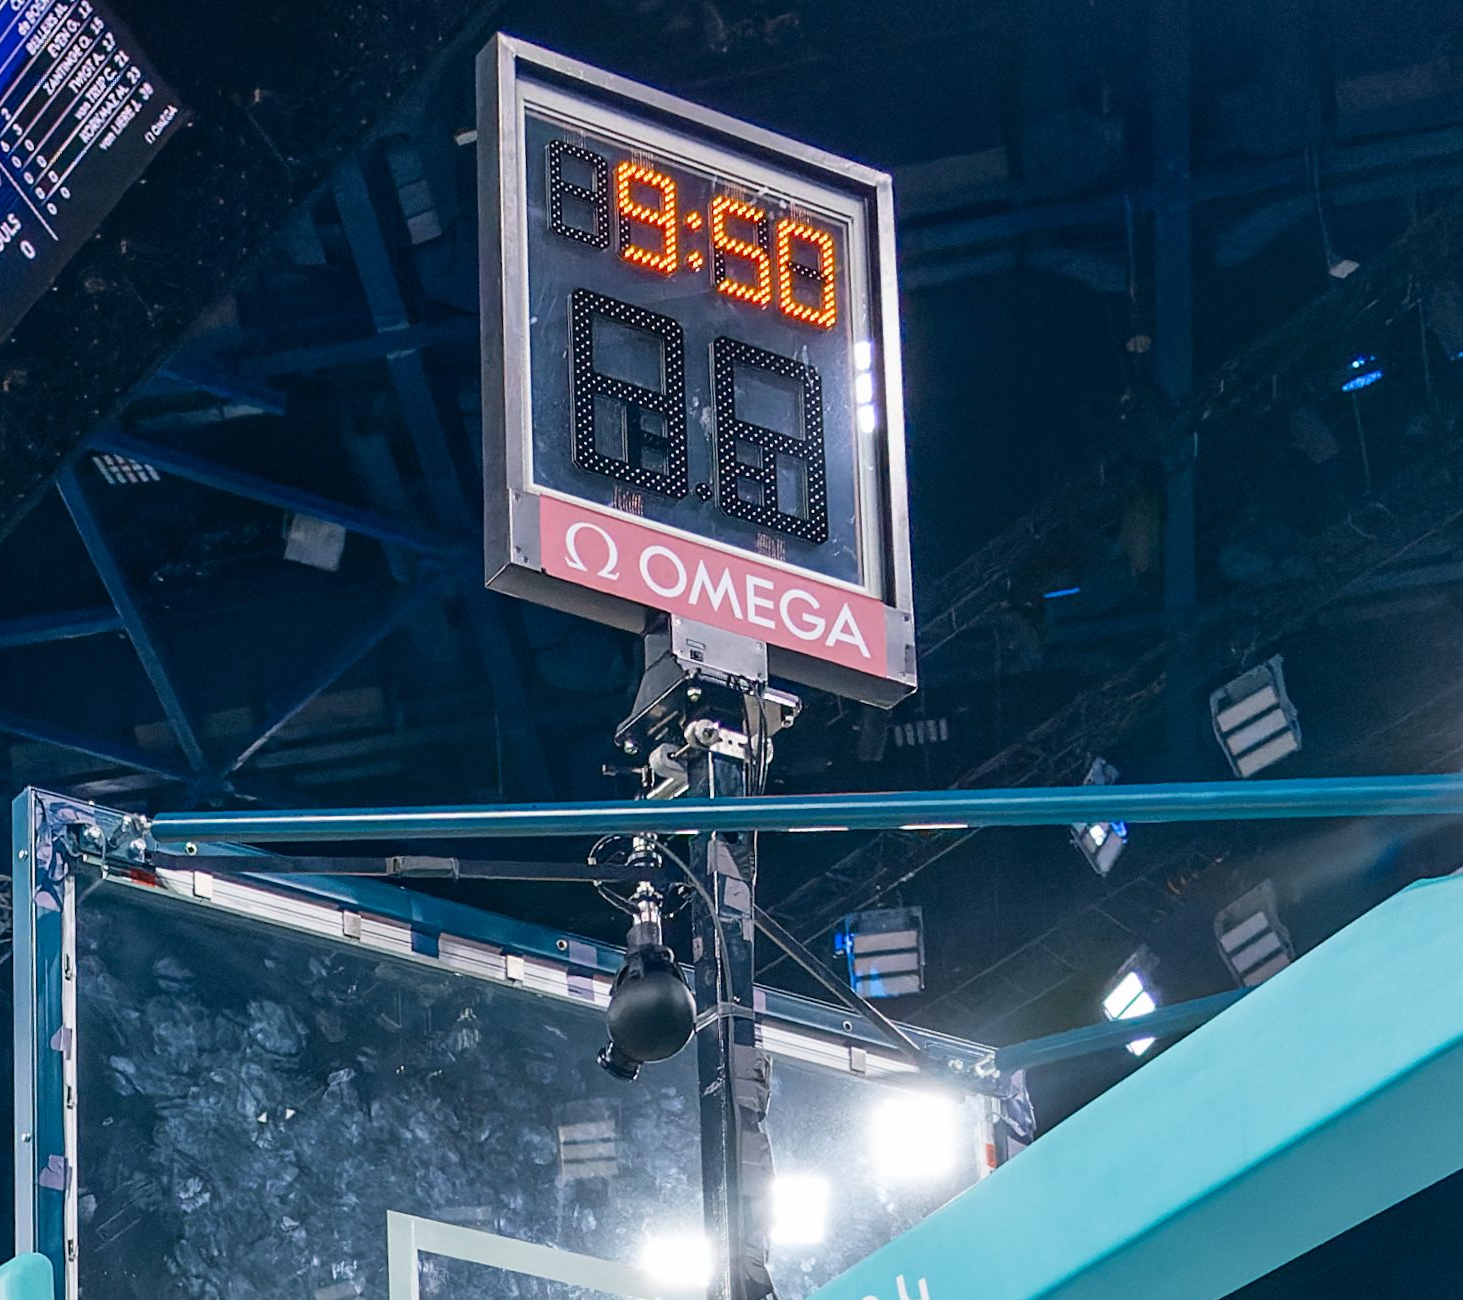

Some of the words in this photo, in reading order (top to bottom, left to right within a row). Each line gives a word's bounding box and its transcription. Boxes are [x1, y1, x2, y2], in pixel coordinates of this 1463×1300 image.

[20, 240, 36, 260] 0
[616, 161, 836, 329] 9:50
[638, 543, 871, 658] OMEGA
